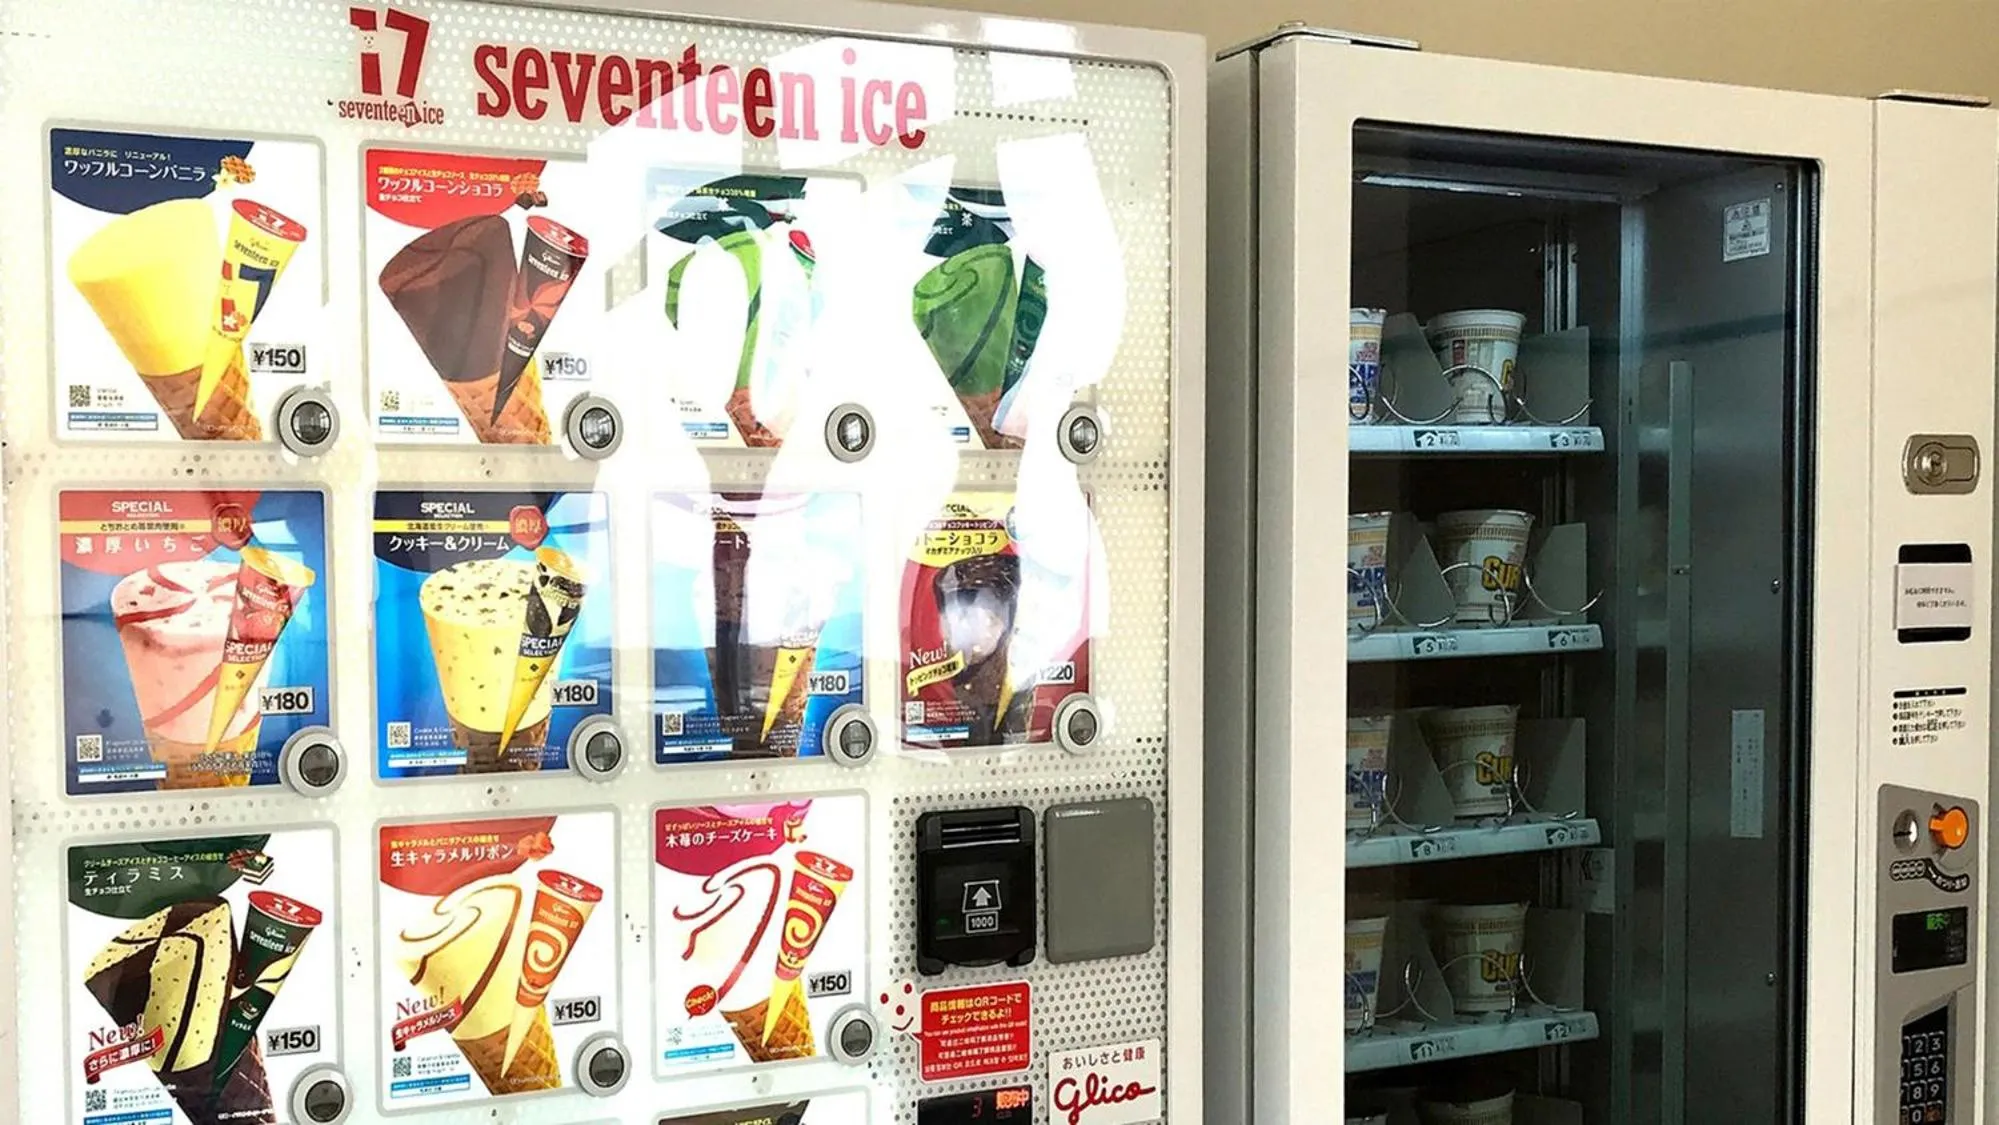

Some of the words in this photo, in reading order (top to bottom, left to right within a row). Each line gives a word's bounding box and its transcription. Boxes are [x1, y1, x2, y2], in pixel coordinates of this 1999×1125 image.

[473, 44, 819, 141] seventeen
[841, 47, 928, 150] ice
[338, 99, 421, 127] seventeen
[422, 100, 445, 125] ice
[64, 159, 207, 182] ワッフルコーンバニラ
[377, 176, 504, 198] ワッフルコーンショコラ
[253, 347, 302, 368] ¥150
[545, 356, 588, 376] ¥150
[111, 500, 173, 514] SPECIAL
[420, 501, 476, 515] SPECIAL
[74, 535, 207, 555] 濃厚いちご
[389, 535, 510, 552] クッキー&クリーム
[908, 640, 949, 670] New!
[553, 684, 596, 703] ¥180
[809, 674, 847, 692] ¥180
[262, 691, 310, 712] ¥180
[665, 827, 777, 849] 木苺のチーズケーキ
[390, 844, 514, 868] 生キャラメルリボン
[83, 865, 184, 887] ティラミス
[971, 915, 995, 929] 1000
[809, 974, 848, 993] ¥150
[395, 984, 446, 1021] New!
[555, 999, 598, 1021] ¥150
[87, 1012, 146, 1053] New!
[269, 1030, 317, 1051] ¥150
[87, 1037, 157, 1073] さらに濃厚に!
[1914, 1039, 1924, 1053] 2
[1931, 1037, 1941, 1051] 3
[1062, 1045, 1146, 1071] おいしさと健康
[1913, 1063, 1923, 1077] 5
[1930, 1061, 1940, 1074] 6
[1053, 1071, 1157, 1125] Glico
[1912, 1086, 1922, 1100] 8
[1930, 1083, 1940, 1098] 9
[1911, 1109, 1922, 1123] 0
